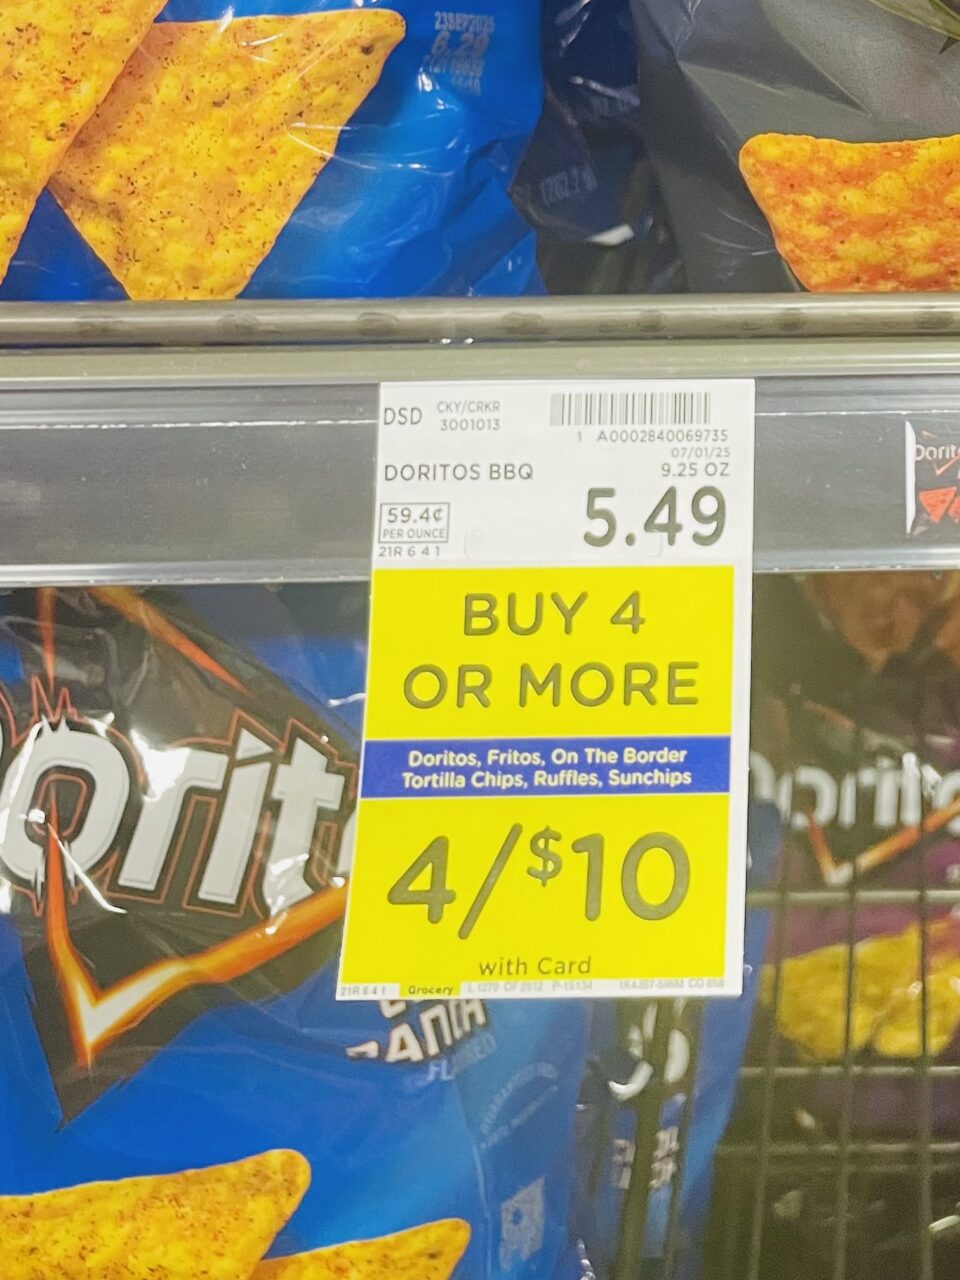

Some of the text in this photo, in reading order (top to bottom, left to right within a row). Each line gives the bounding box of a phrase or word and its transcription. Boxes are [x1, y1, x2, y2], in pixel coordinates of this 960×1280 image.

[383, 400, 501, 425] DSD CKY/CRKR
[440, 418, 501, 431] 3001013
[596, 429, 729, 443] A0002840069735
[671, 446, 731, 459] 07/01/25
[384, 463, 534, 482] DORITOS BBQ
[661, 462, 731, 477] 9.25 OZ
[387, 507, 443, 524] 59.4¢
[583, 485, 727, 548] 5.49
[382, 528, 446, 539] PER OUNCE
[378, 546, 403, 557] 21R
[407, 546, 416, 557] 6
[421, 546, 430, 557] 4
[463, 591, 646, 637] BUY 4
[403, 661, 700, 710] OR MORE
[408, 746, 688, 769] Doritos, Fritos, On The Border
[401, 768, 693, 791] Tortilla Chips, Ruffles, Sunchips
[0, 716, 354, 916] orit
[387, 822, 691, 941] 4/$10
[479, 955, 592, 976] with Card
[408, 984, 454, 997] Grocery
